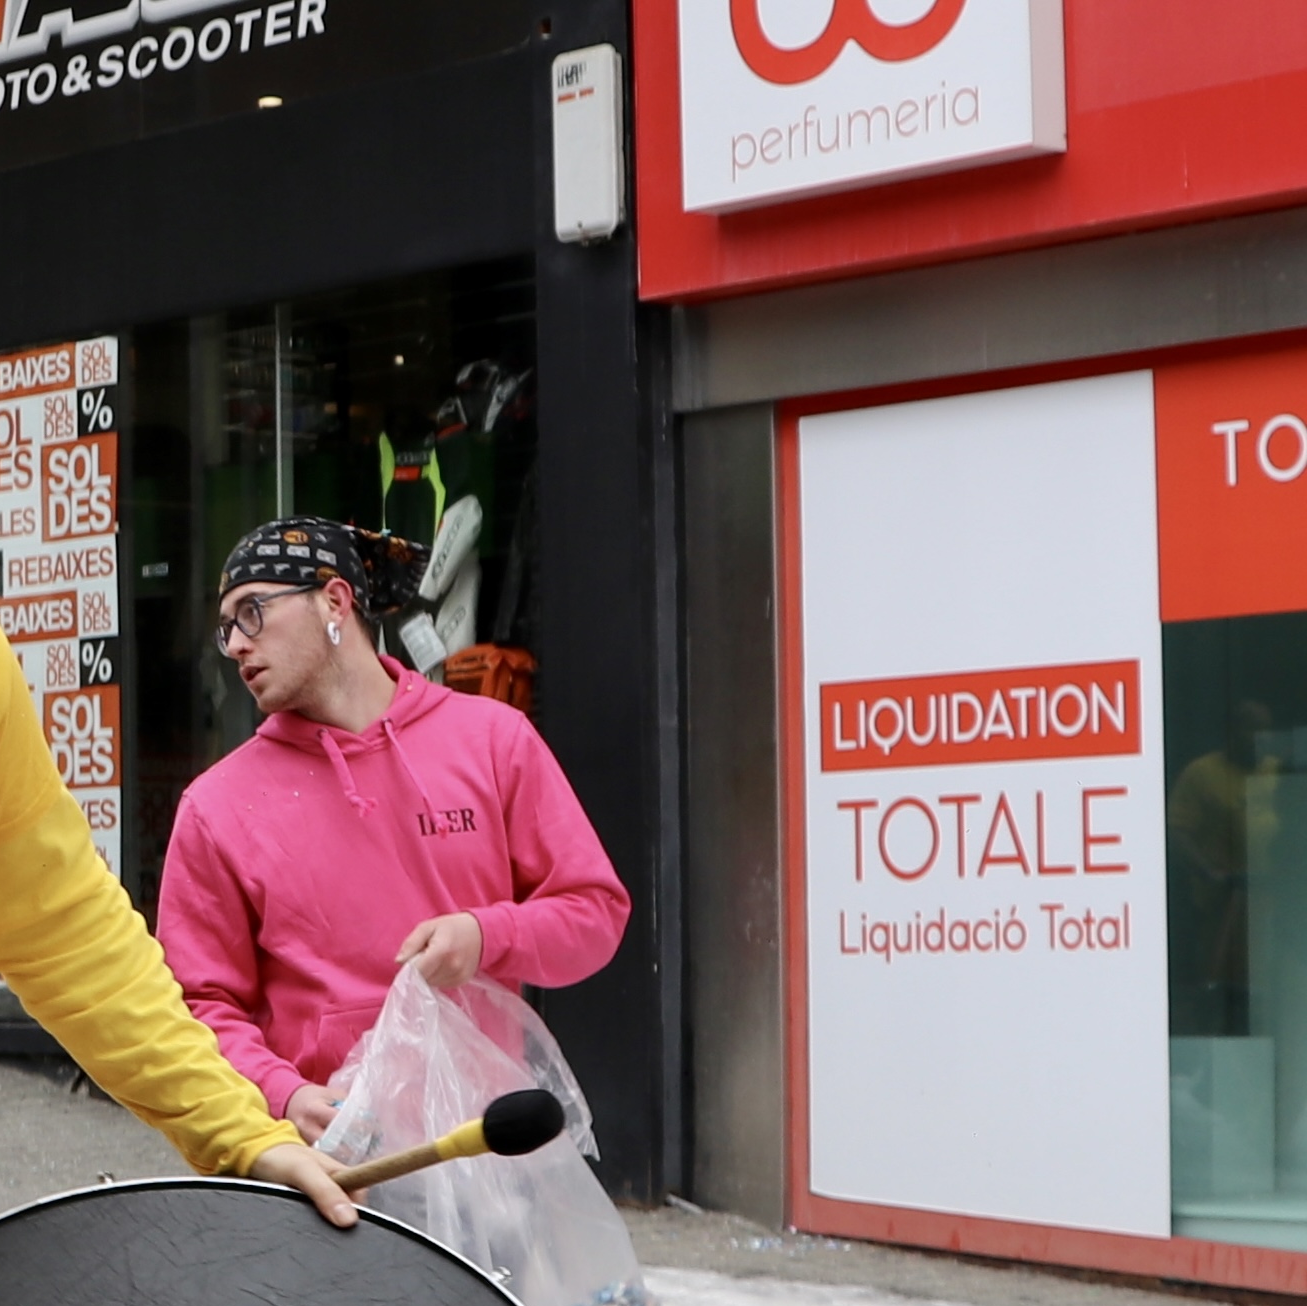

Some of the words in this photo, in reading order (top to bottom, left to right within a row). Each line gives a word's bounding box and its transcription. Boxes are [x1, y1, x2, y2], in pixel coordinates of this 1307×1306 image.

[732, 80, 979, 183] perfumeria
[81, 341, 110, 362] SOL
[81, 361, 112, 384] DES
[44, 394, 72, 416] SOL
[44, 415, 74, 440] DES
[48, 443, 111, 493] SOL
[1212, 413, 1307, 487] TO
[49, 486, 112, 538] DES
[8, 546, 114, 588] REBAIXES
[82, 609, 112, 632] DES
[83, 592, 110, 612] SOL
[46, 662, 77, 687] DES
[47, 643, 74, 665] SOL
[51, 694, 113, 742] SOL
[833, 680, 1125, 755] LIQUIDATION
[837, 786, 1130, 882] TOTALE
[840, 905, 1028, 964] Liquidació
[1040, 902, 1131, 951] Total
